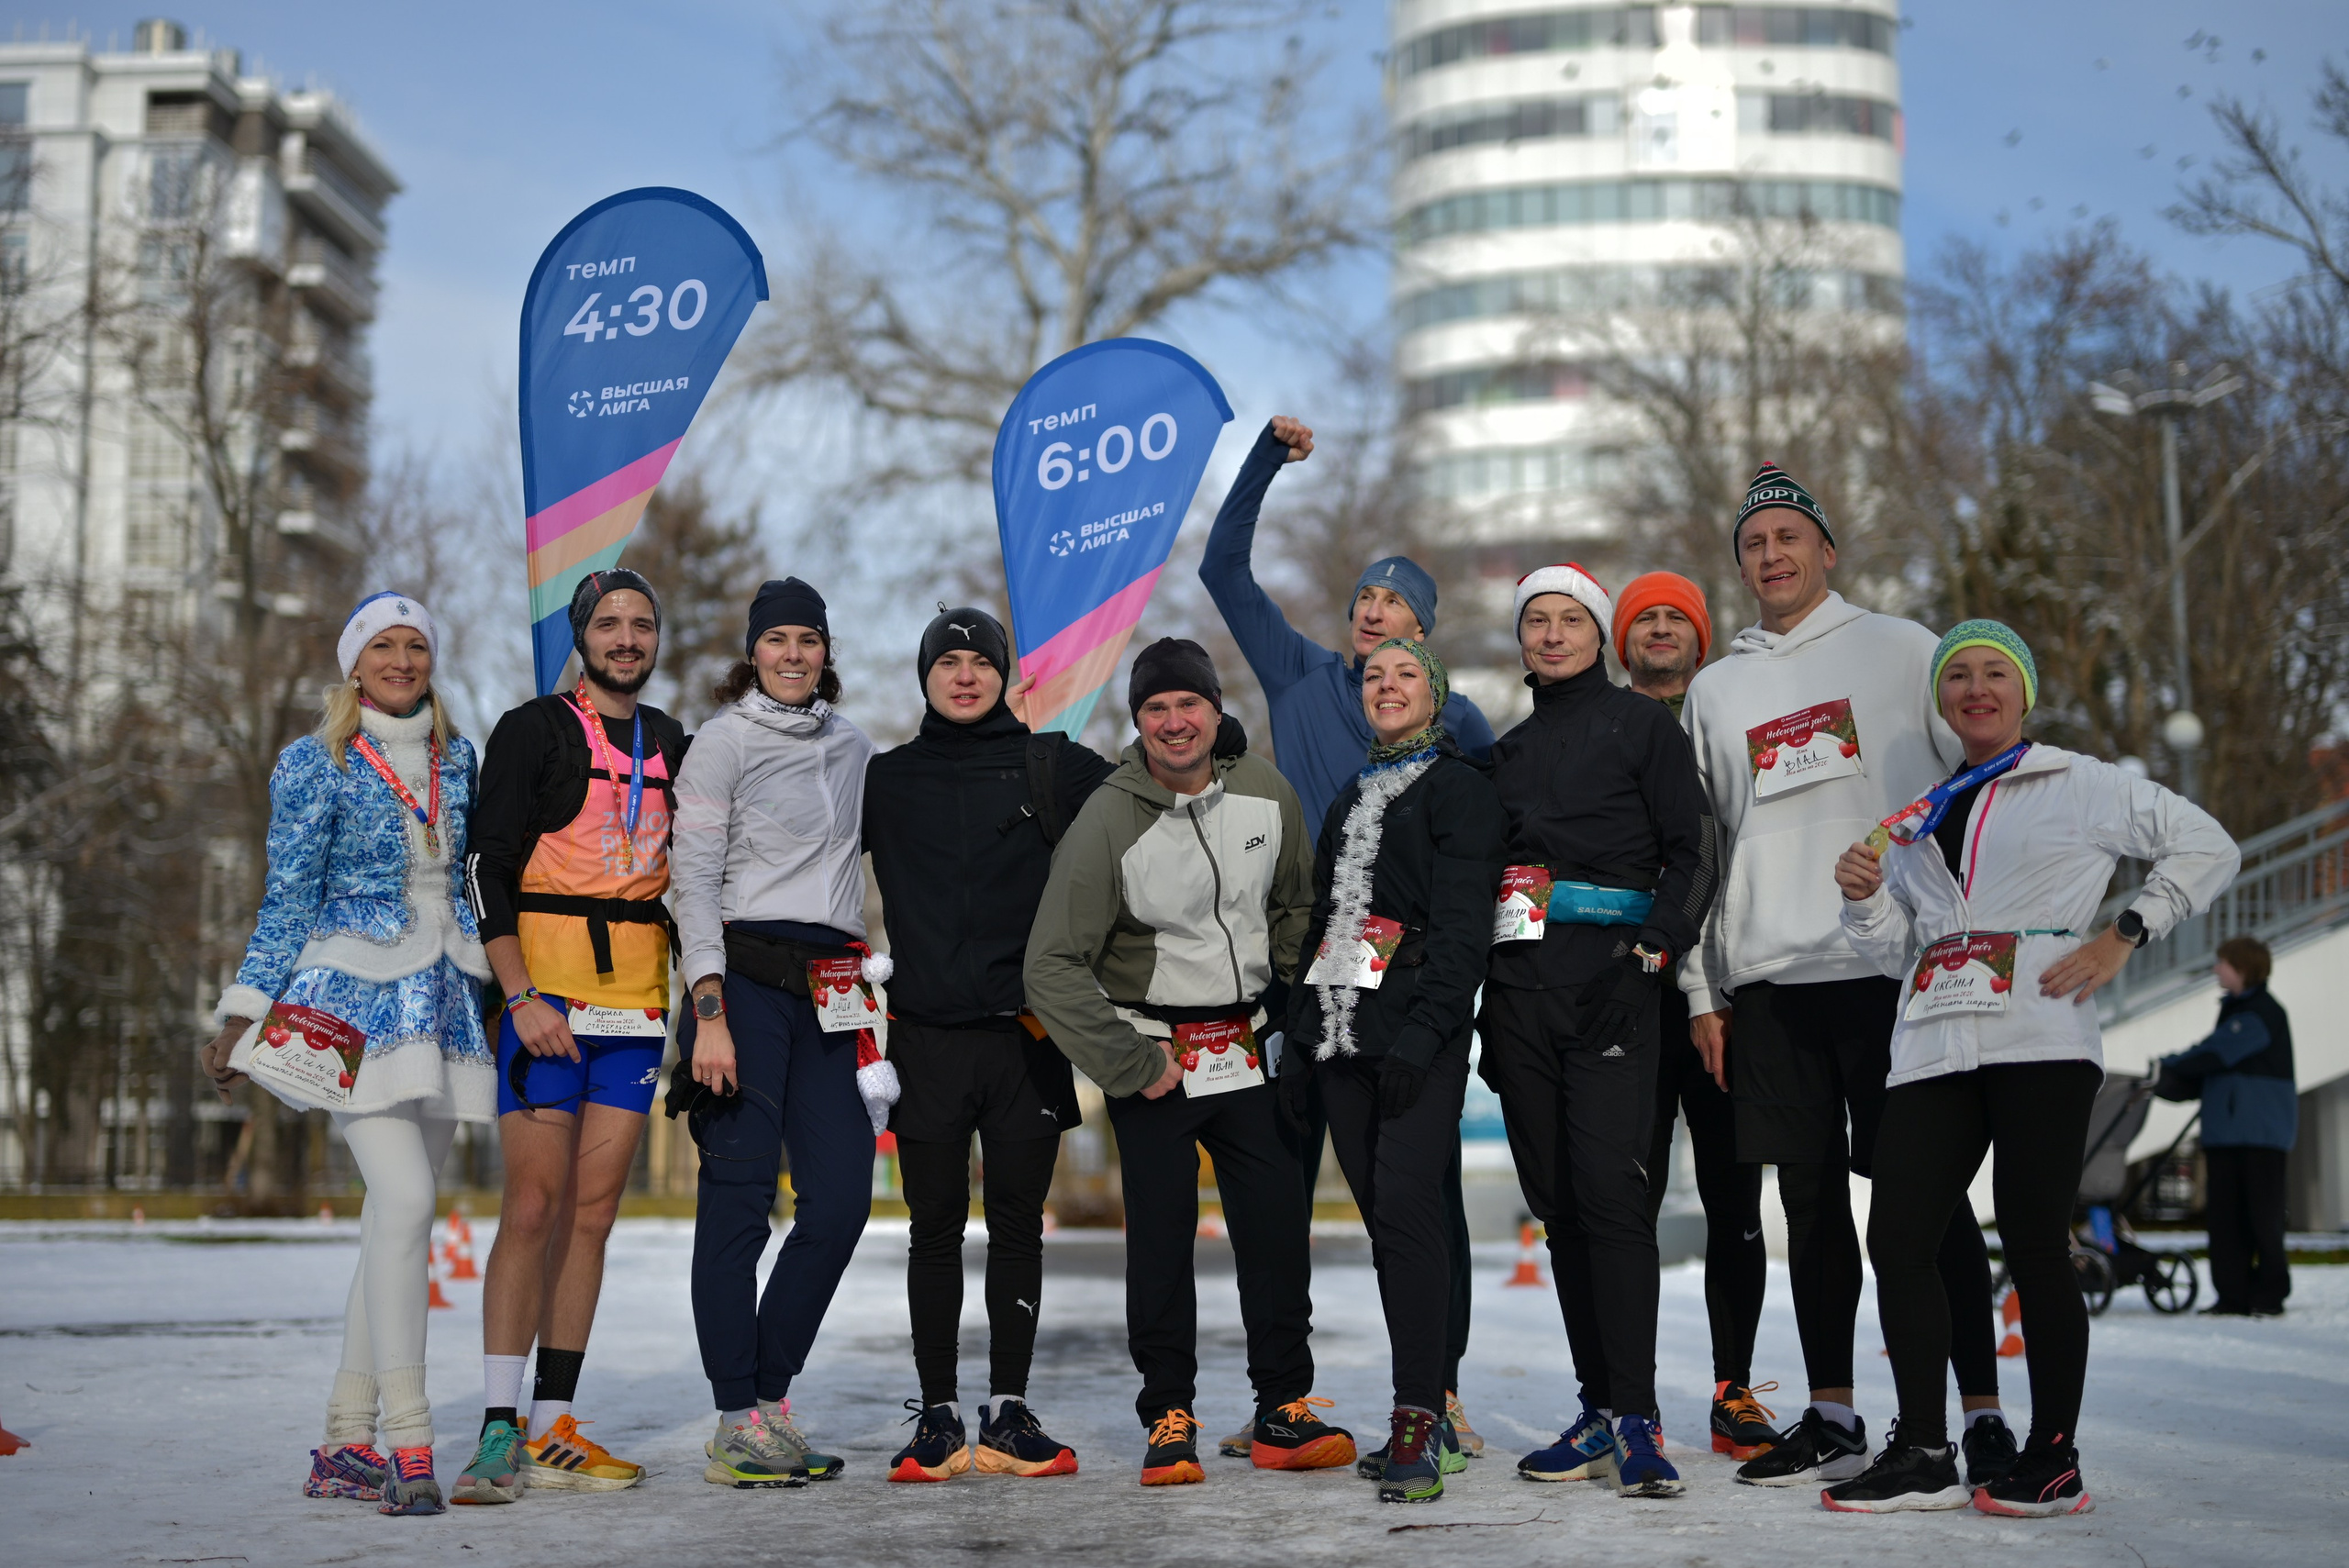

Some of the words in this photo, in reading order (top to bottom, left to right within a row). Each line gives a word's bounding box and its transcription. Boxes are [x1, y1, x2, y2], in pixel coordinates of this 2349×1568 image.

[566, 256, 636, 280] темп
[562, 278, 707, 343] 4:30
[600, 376, 689, 399] ВЫСШАЯ
[598, 397, 651, 417] ЛИГА
[1029, 403, 1097, 435] темп
[1037, 413, 1177, 491] 6:00
[1080, 502, 1165, 537] ВЫСШАЯ
[1080, 528, 1130, 553] ЛИГА
[1766, 719, 1809, 740] Новогодний
[1810, 713, 1831, 729] забег
[1513, 876, 1533, 887] забег
[1577, 906, 1622, 916] SALOMON
[1363, 926, 1382, 937] забег
[1968, 942, 1991, 954] забег
[1934, 978, 1974, 992] ОКСАНА
[588, 1006, 624, 1019] Кирилл
[270, 1031, 283, 1040] 96
[288, 1013, 334, 1036] Новогодний
[331, 1033, 351, 1045] забег
[1189, 1028, 1227, 1042] Новогодний
[1227, 1025, 1240, 1040] забег
[275, 1044, 337, 1078] Ирина
[1186, 1057, 1195, 1065] 62
[1208, 1061, 1233, 1073] ИВАН
[312, 1073, 327, 1083] 2020
